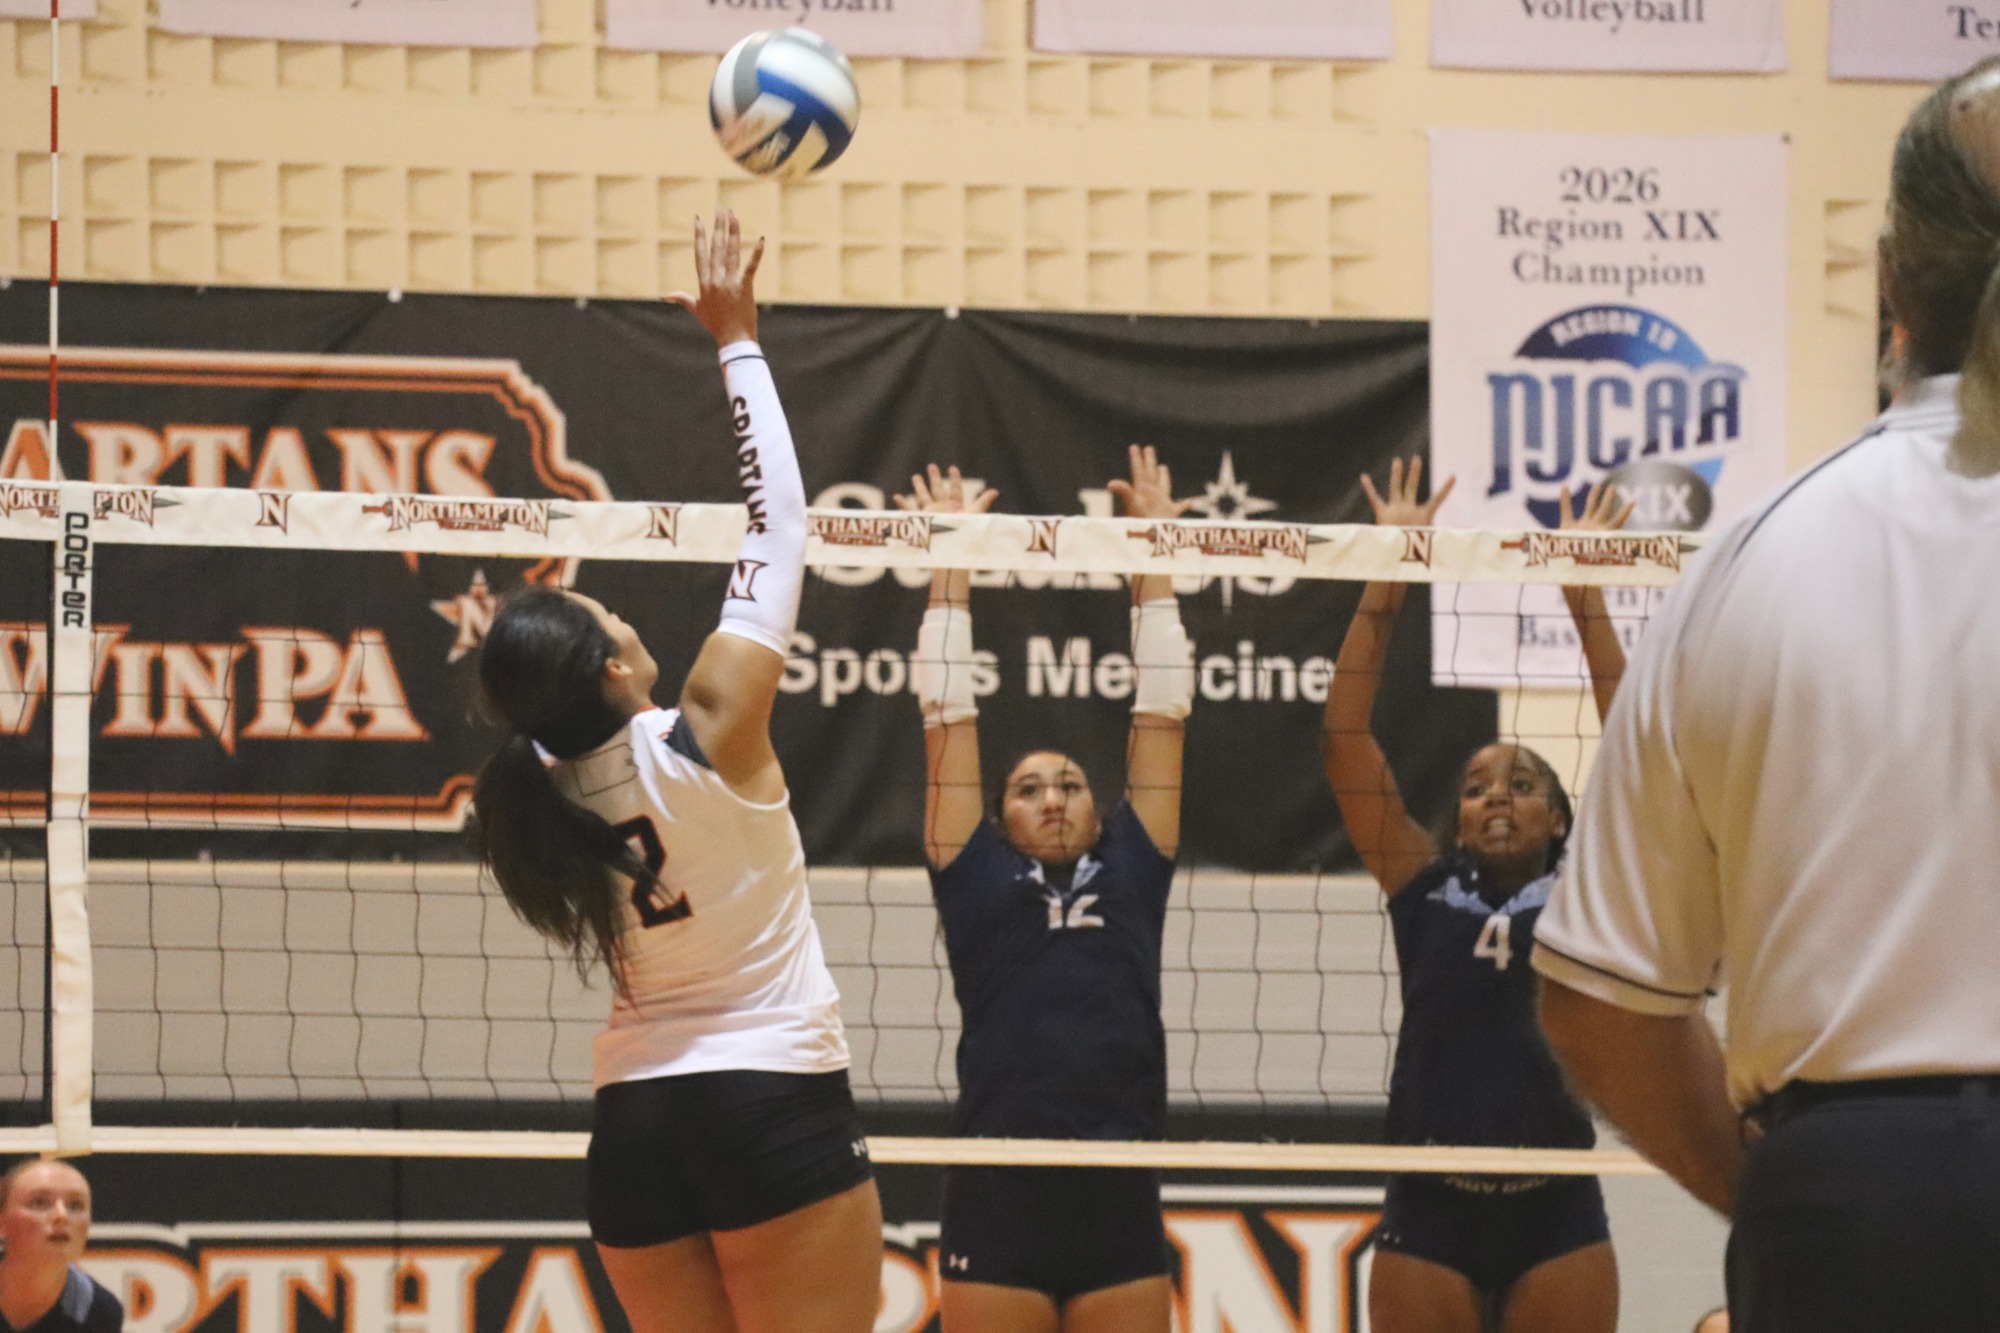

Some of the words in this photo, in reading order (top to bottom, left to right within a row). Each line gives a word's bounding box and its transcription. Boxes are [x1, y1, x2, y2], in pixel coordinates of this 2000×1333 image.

[1520, 0, 1706, 33] Volleyball
[1946, 5, 2000, 39] Te
[1559, 166, 1660, 203] 2026
[1496, 207, 1624, 251] Region
[1643, 209, 1722, 242] XIX
[1511, 250, 1707, 296] Champion
[1486, 360, 1748, 499] NJCAA
[256, 493, 292, 534] N
[387, 496, 552, 540] NORTHAMPTON
[645, 504, 682, 547] N
[806, 514, 933, 553] RTHAMPTON
[1025, 518, 1062, 560] N
[1150, 522, 1311, 565] NORTHAMPTON
[1400, 528, 1436, 570] N
[1525, 532, 1682, 574] NORTHAMPTON
[62, 511, 89, 628] PORTER
[779, 629, 1000, 707] Spos
[1026, 635, 1337, 702] Mecine
[607, 813, 695, 929] 2
[1042, 893, 1105, 930] 12
[1473, 913, 1513, 971] 4
